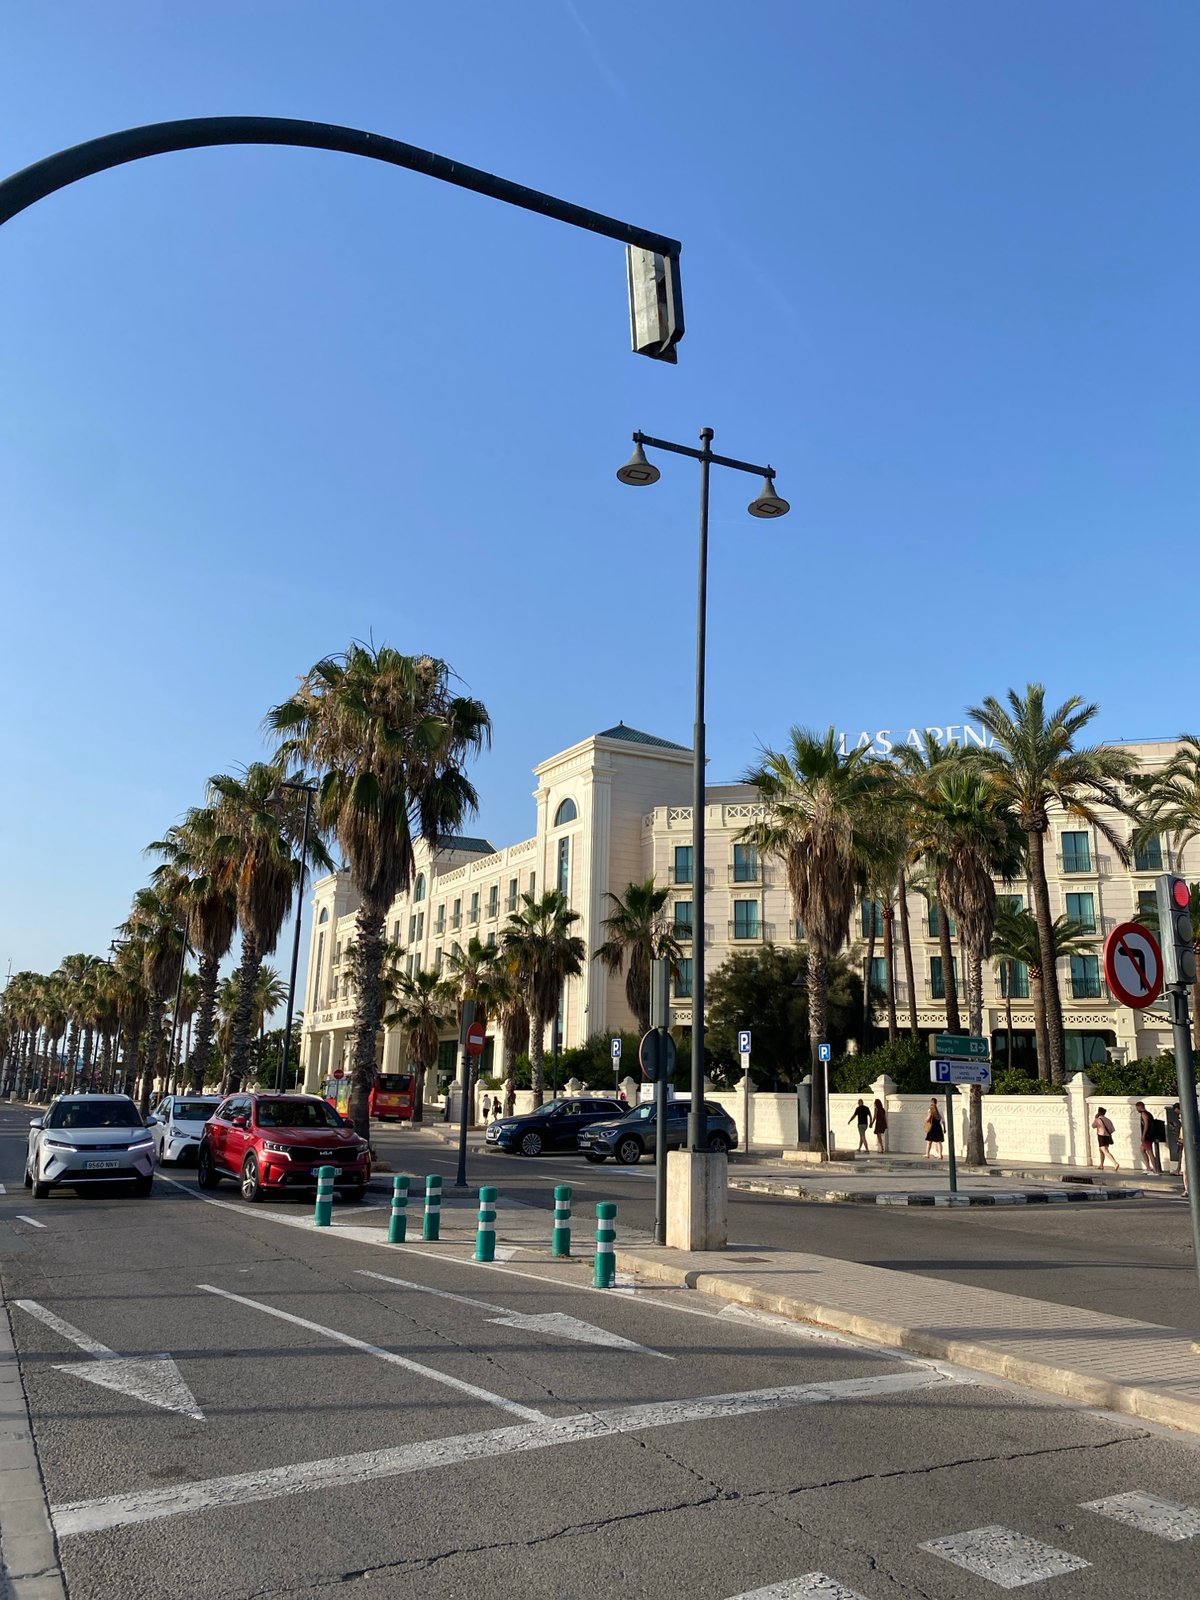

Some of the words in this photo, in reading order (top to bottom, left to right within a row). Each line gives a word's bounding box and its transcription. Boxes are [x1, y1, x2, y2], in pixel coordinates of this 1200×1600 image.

[838, 730, 893, 756] LAS
[613, 1041, 619, 1056] P
[740, 1034, 748, 1051] P
[821, 1046, 828, 1059] P
[938, 1063, 949, 1080] P
